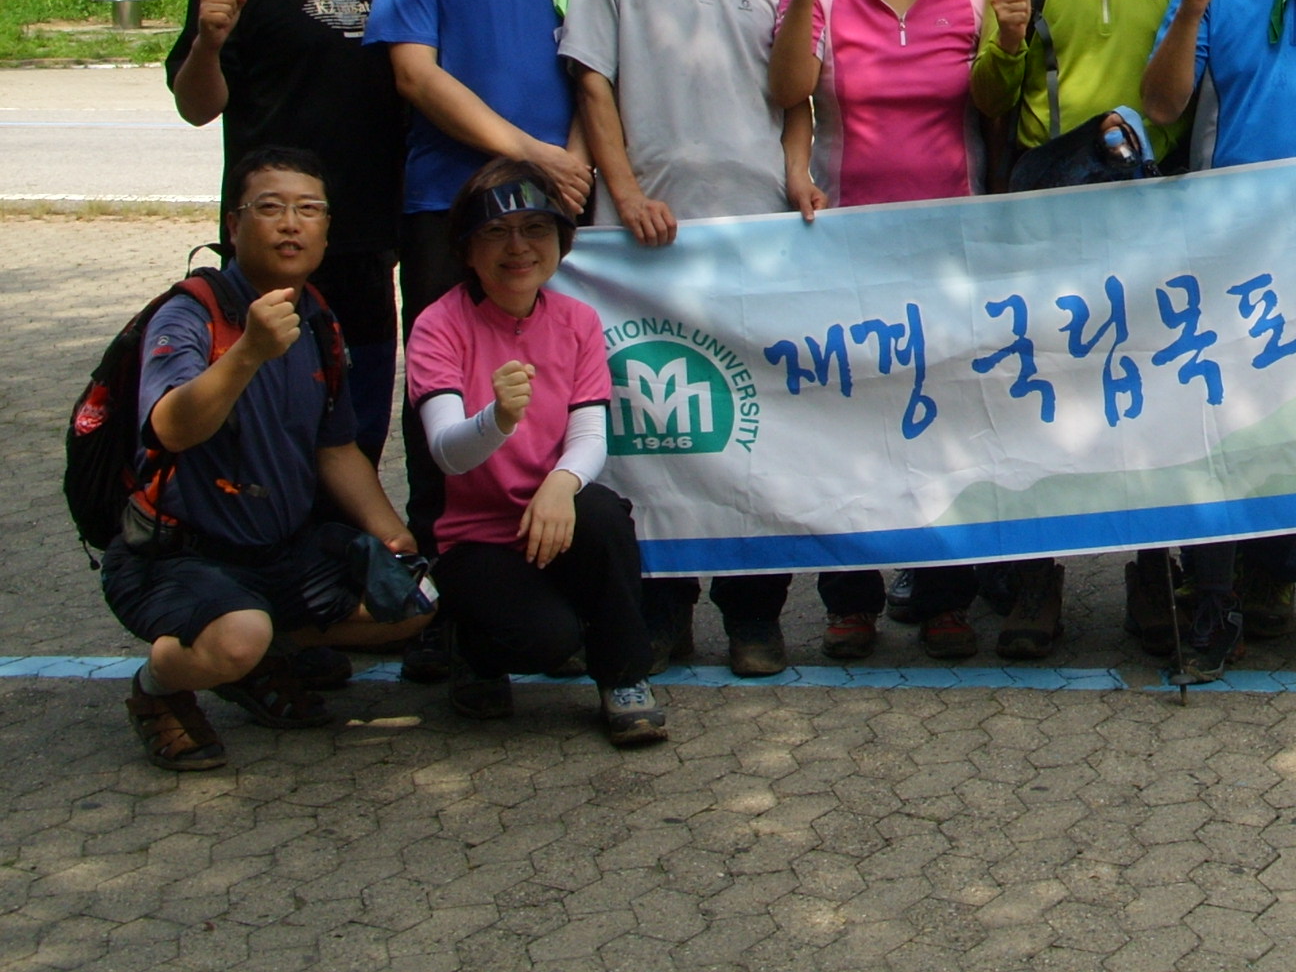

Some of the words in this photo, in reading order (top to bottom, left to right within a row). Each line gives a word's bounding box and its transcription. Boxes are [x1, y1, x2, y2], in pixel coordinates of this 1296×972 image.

[602, 317, 688, 350] TIONAL
[691, 329, 760, 454] UNIVERSITY
[763, 303, 938, 440] 재경
[632, 436, 693, 450] 1946
